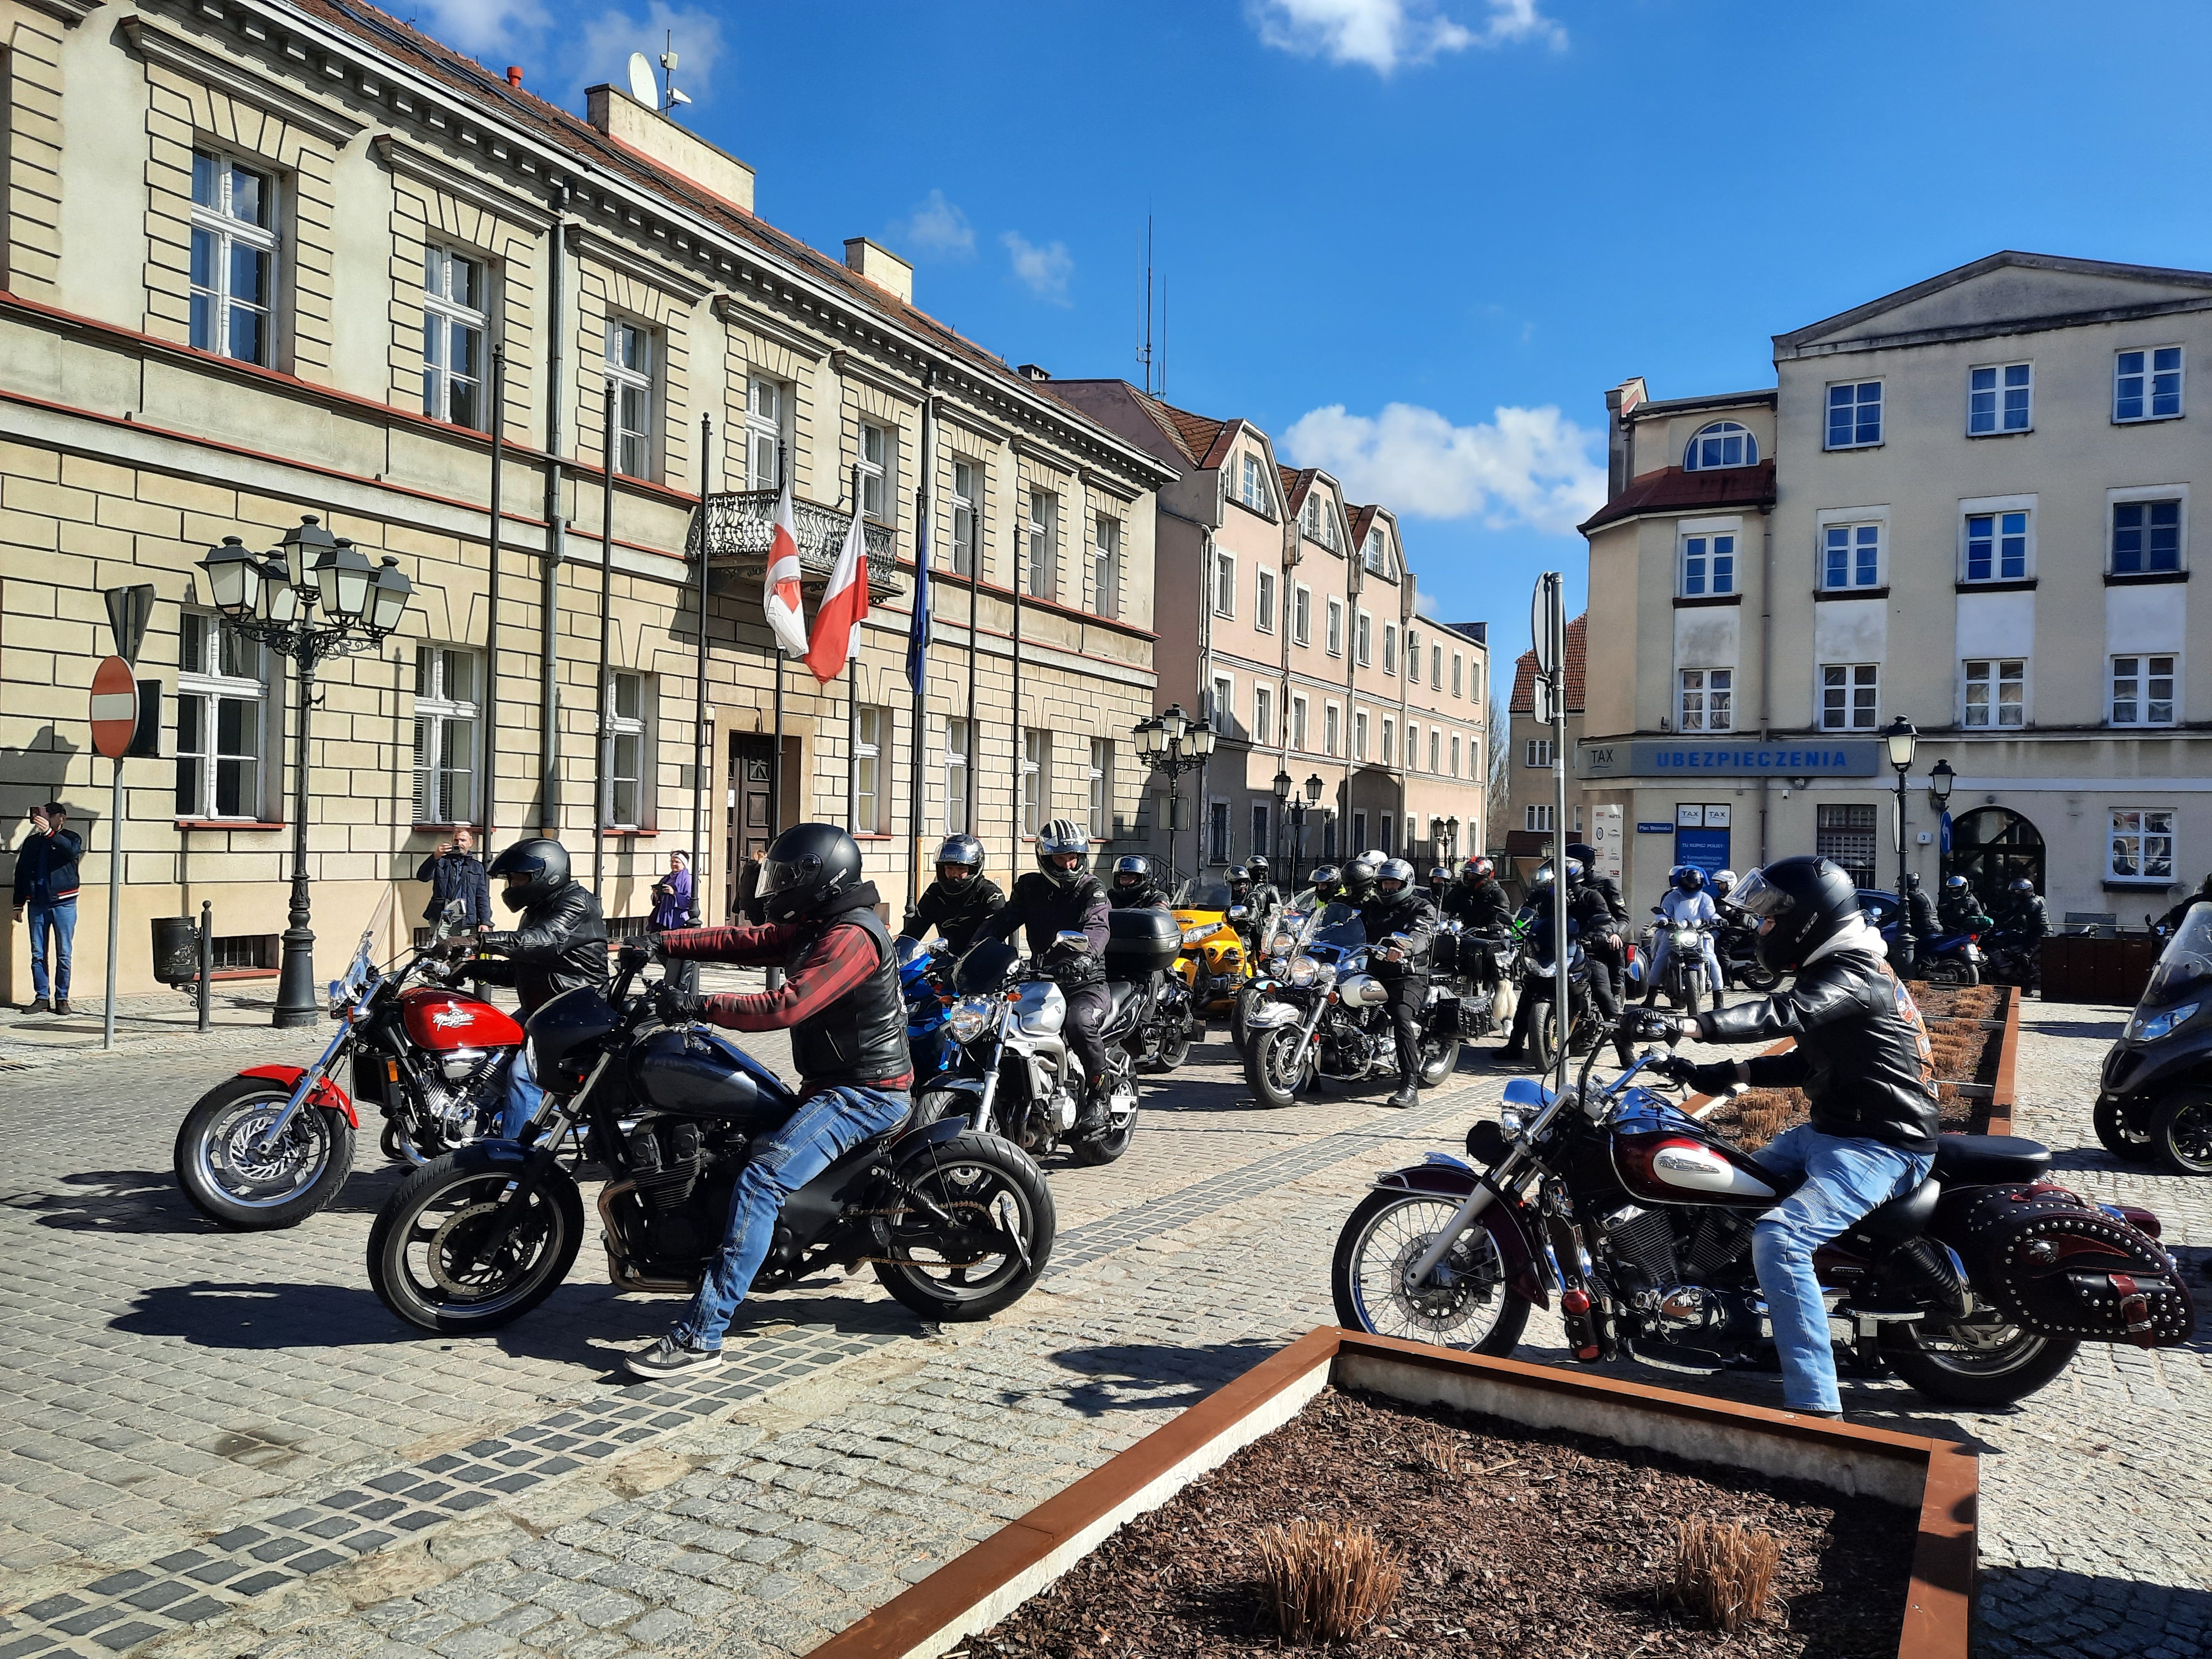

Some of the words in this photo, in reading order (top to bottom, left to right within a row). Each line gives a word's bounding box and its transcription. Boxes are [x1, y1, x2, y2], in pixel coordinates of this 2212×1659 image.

[1591, 749, 1614, 763] TAX
[1657, 751, 1847, 767] UBEZPIECZENIA
[1795, 911, 1819, 943] LS2
